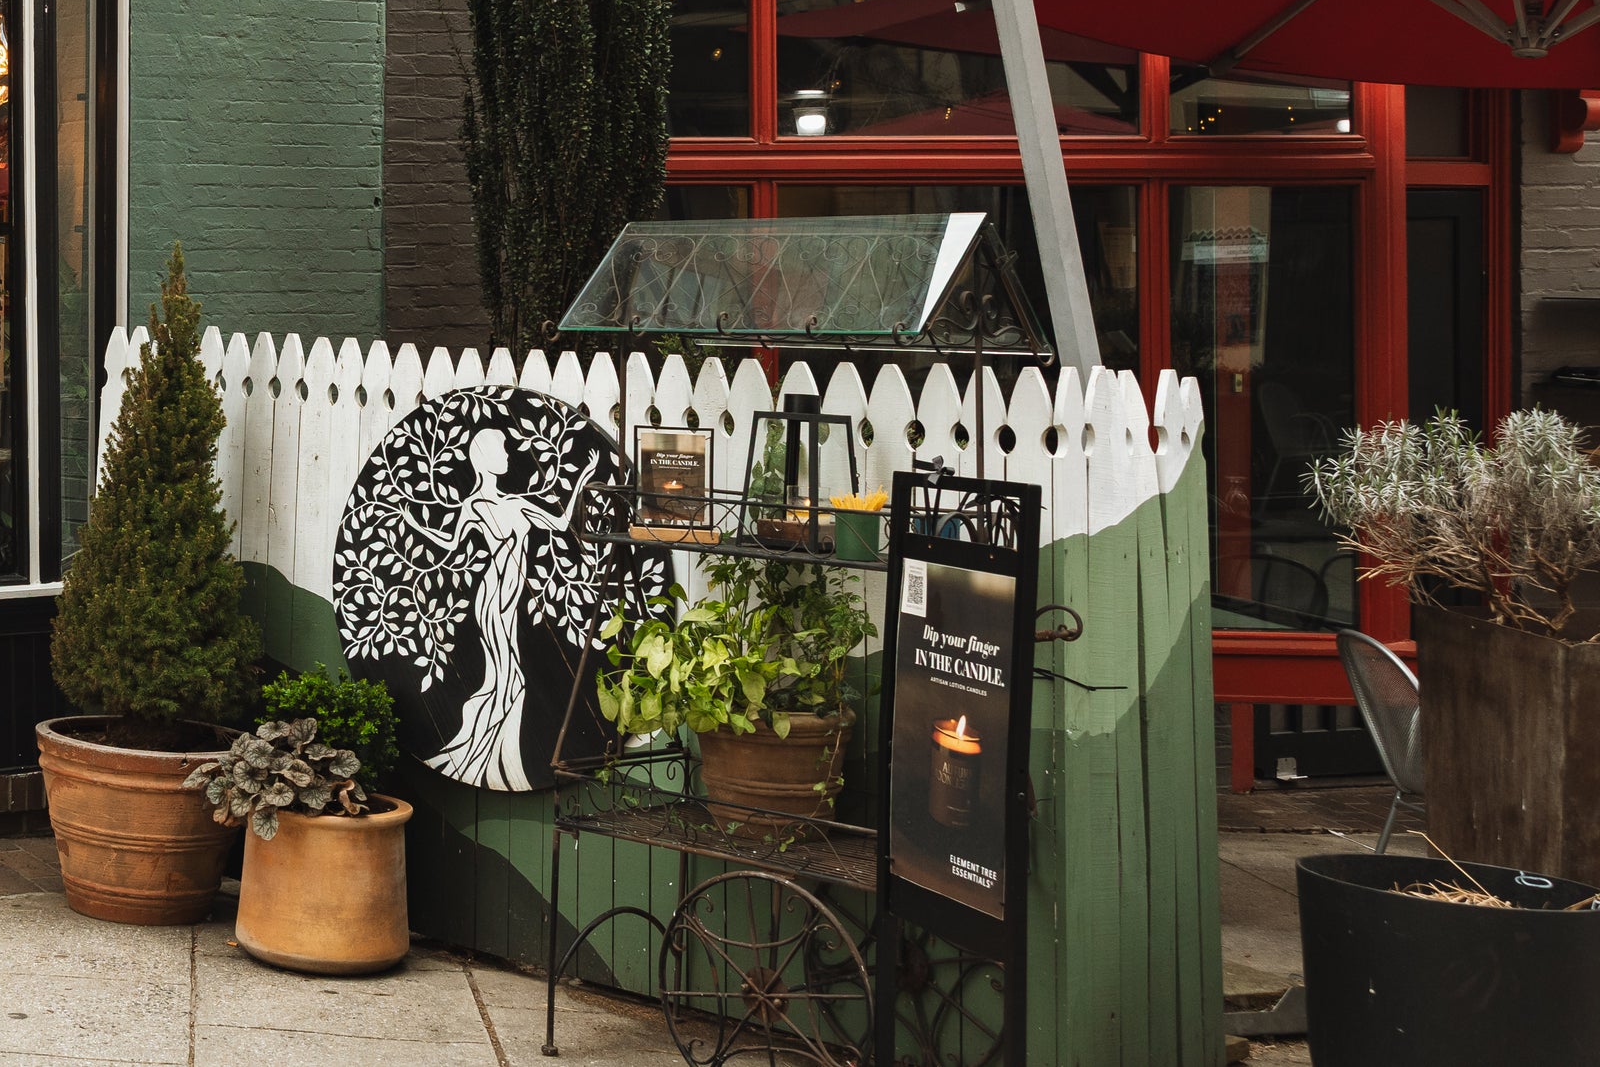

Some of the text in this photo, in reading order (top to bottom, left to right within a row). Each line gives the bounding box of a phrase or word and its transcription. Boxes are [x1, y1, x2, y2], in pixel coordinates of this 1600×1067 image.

[923, 624, 1000, 659] Dip your finger
[915, 648, 1005, 687] IN THE CANDLE.
[930, 676, 988, 696] ARTISAN LOTION CANDLES
[949, 854, 998, 881] ELEMENT TREE
